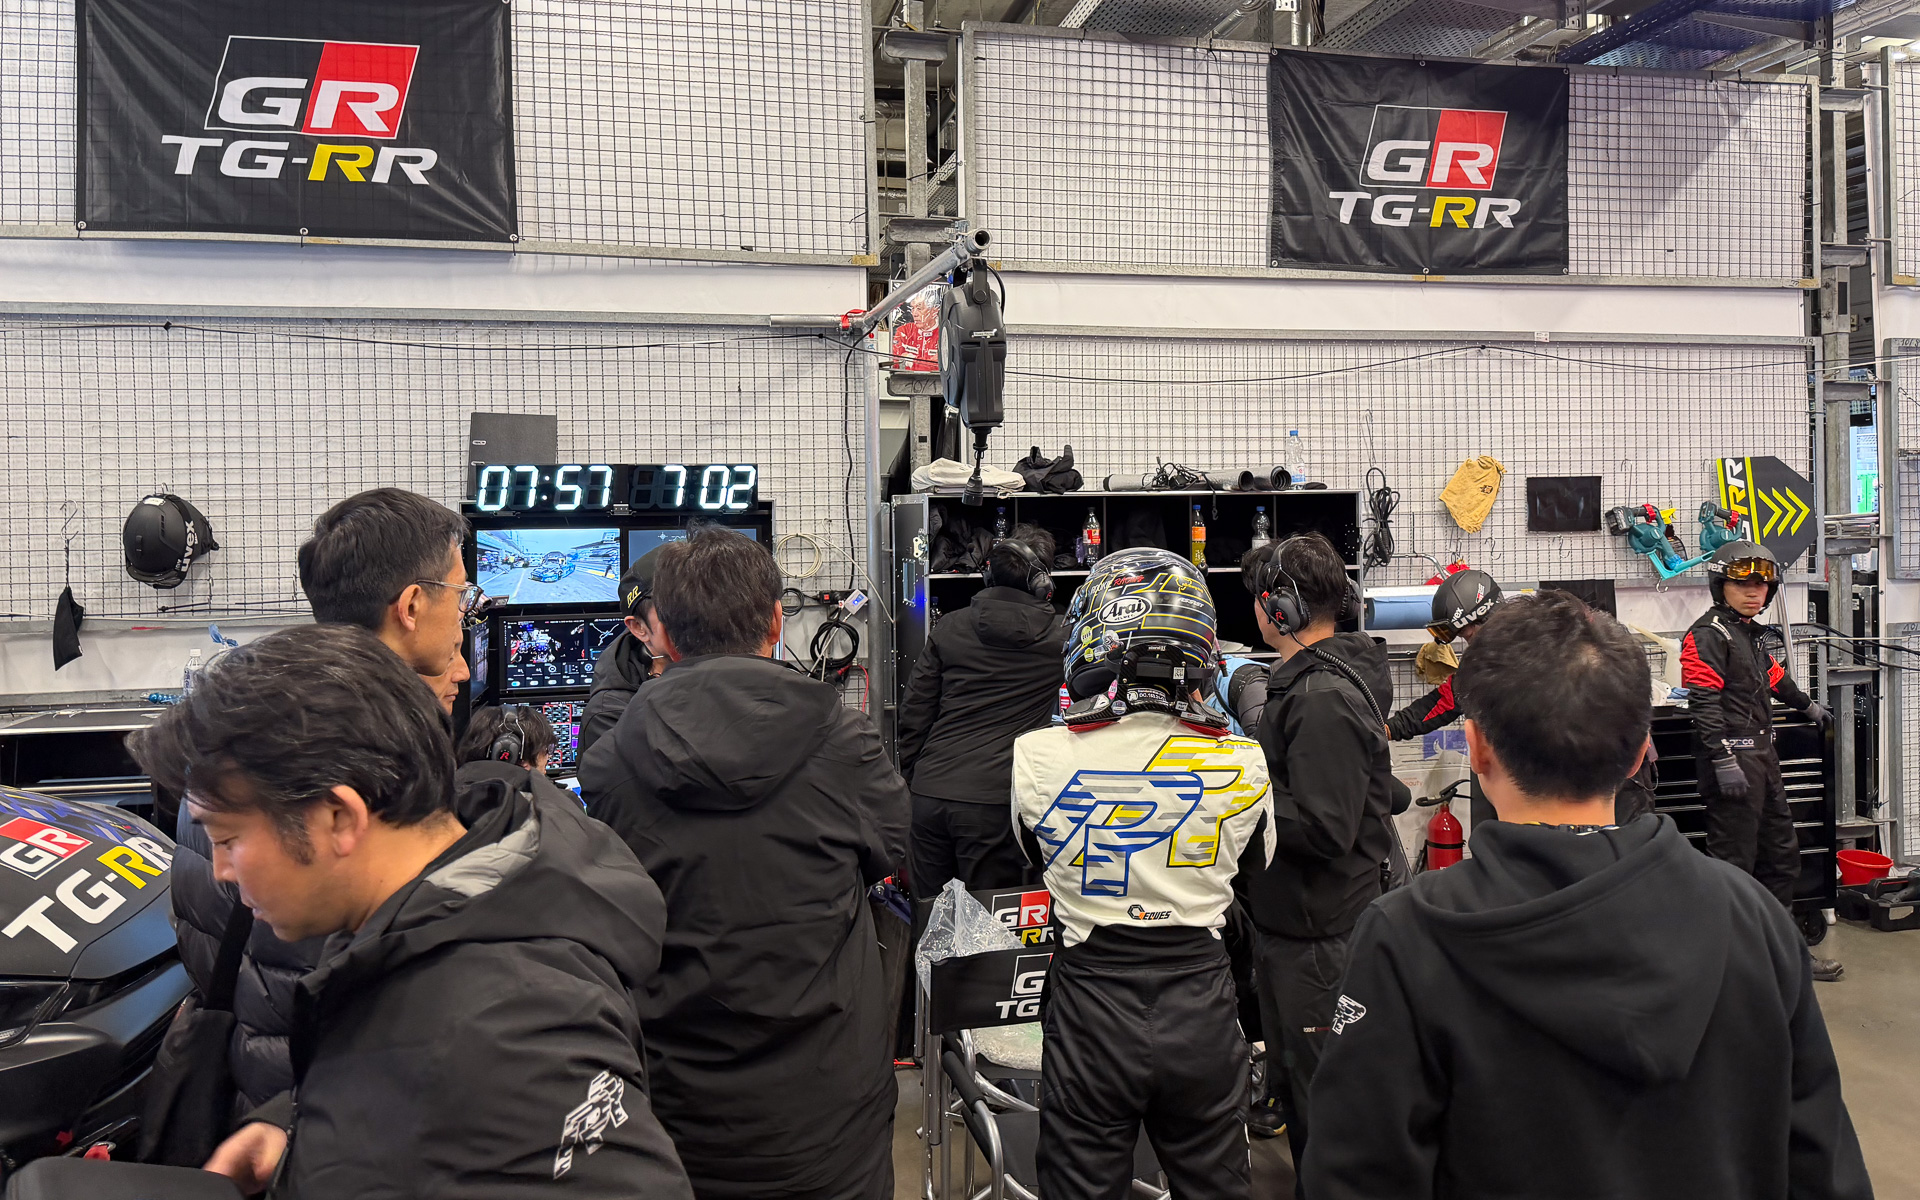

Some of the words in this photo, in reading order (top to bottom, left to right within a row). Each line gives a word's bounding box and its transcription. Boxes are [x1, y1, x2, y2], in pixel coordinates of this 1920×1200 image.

[218, 77, 399, 131] GR
[161, 134, 438, 185] TG-RR
[1367, 140, 1494, 185] GR
[1329, 191, 1521, 229] TG-RR
[478, 464, 613, 511] 07:57
[180, 520, 195, 572] uvex
[1103, 599, 1143, 621] Arai
[1453, 598, 1494, 629] uvex
[0, 828, 85, 873] GR
[1, 836, 173, 954] TG-RR
[995, 905, 1048, 928] GR
[1014, 970, 1047, 995] G
